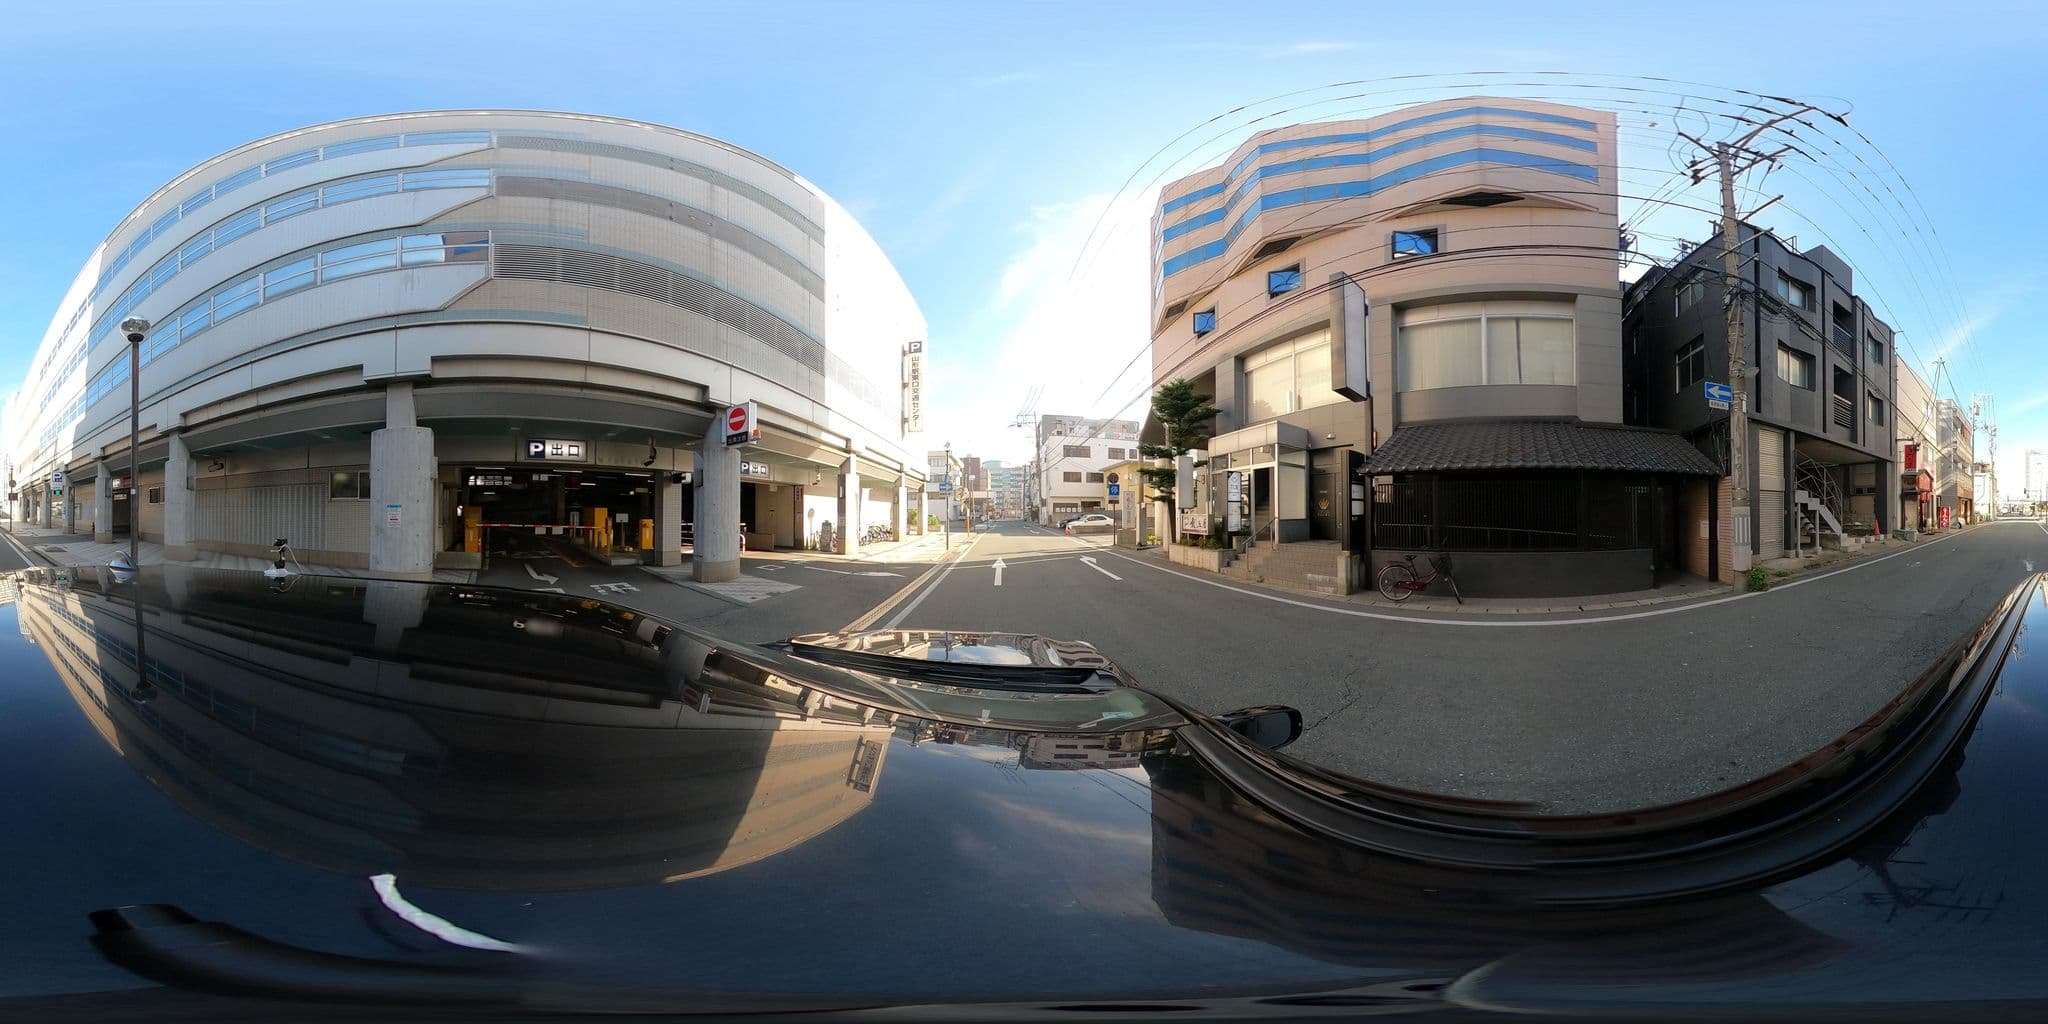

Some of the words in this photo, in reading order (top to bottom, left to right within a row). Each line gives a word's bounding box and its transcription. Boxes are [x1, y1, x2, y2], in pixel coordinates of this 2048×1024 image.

[911, 343, 920, 352] P
[911, 355, 920, 428] 山形駅東口交通センター
[529, 442, 544, 456] P
[551, 443, 580, 457] 出口
[741, 463, 749, 473] P
[752, 464, 767, 474] 出口
